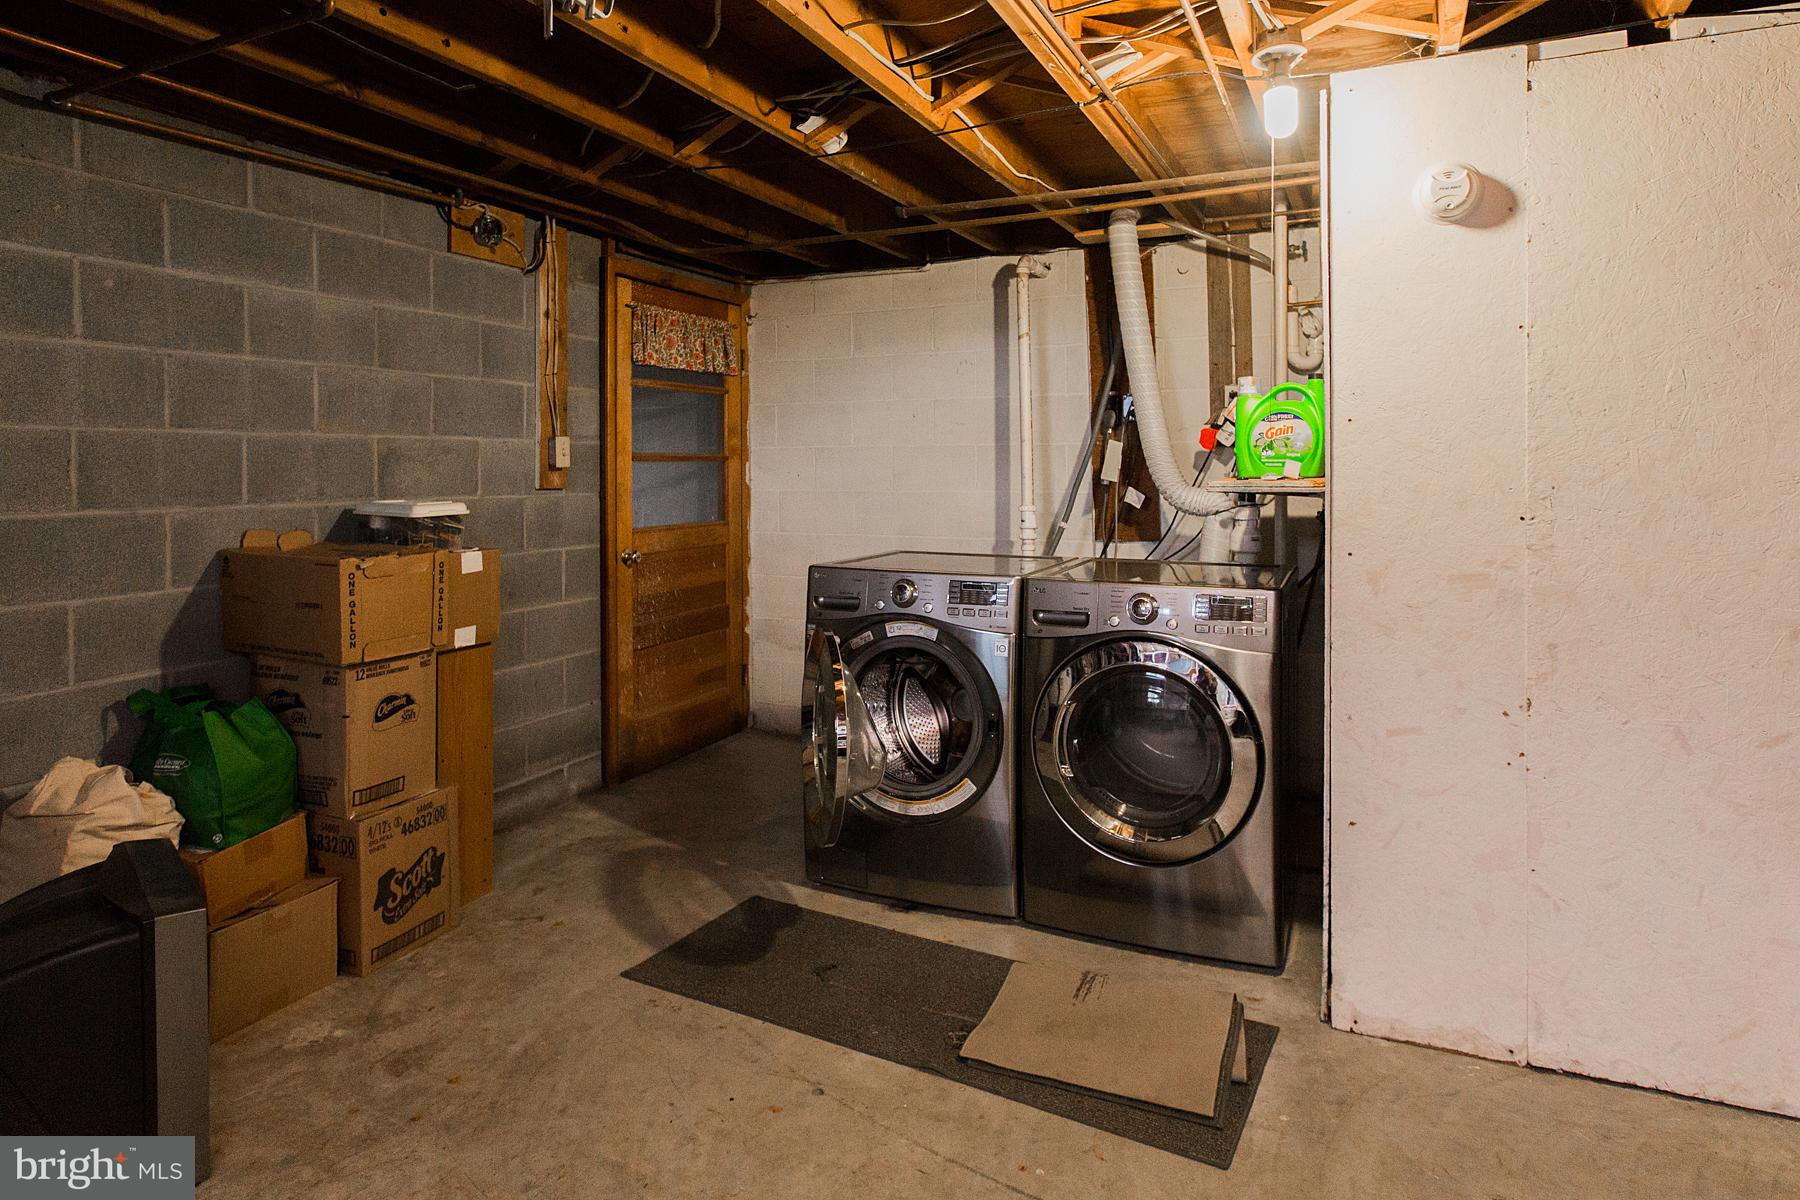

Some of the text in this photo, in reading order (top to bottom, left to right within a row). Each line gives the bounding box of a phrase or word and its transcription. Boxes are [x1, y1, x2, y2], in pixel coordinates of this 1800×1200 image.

[1265, 424, 1295, 440] Gain
[348, 601, 356, 649] GALLON
[355, 669, 365, 681] 12
[377, 695, 407, 717] Charmin
[290, 713, 307, 725] Soft
[401, 710, 416, 720] Soft
[386, 847, 435, 909] Scott
